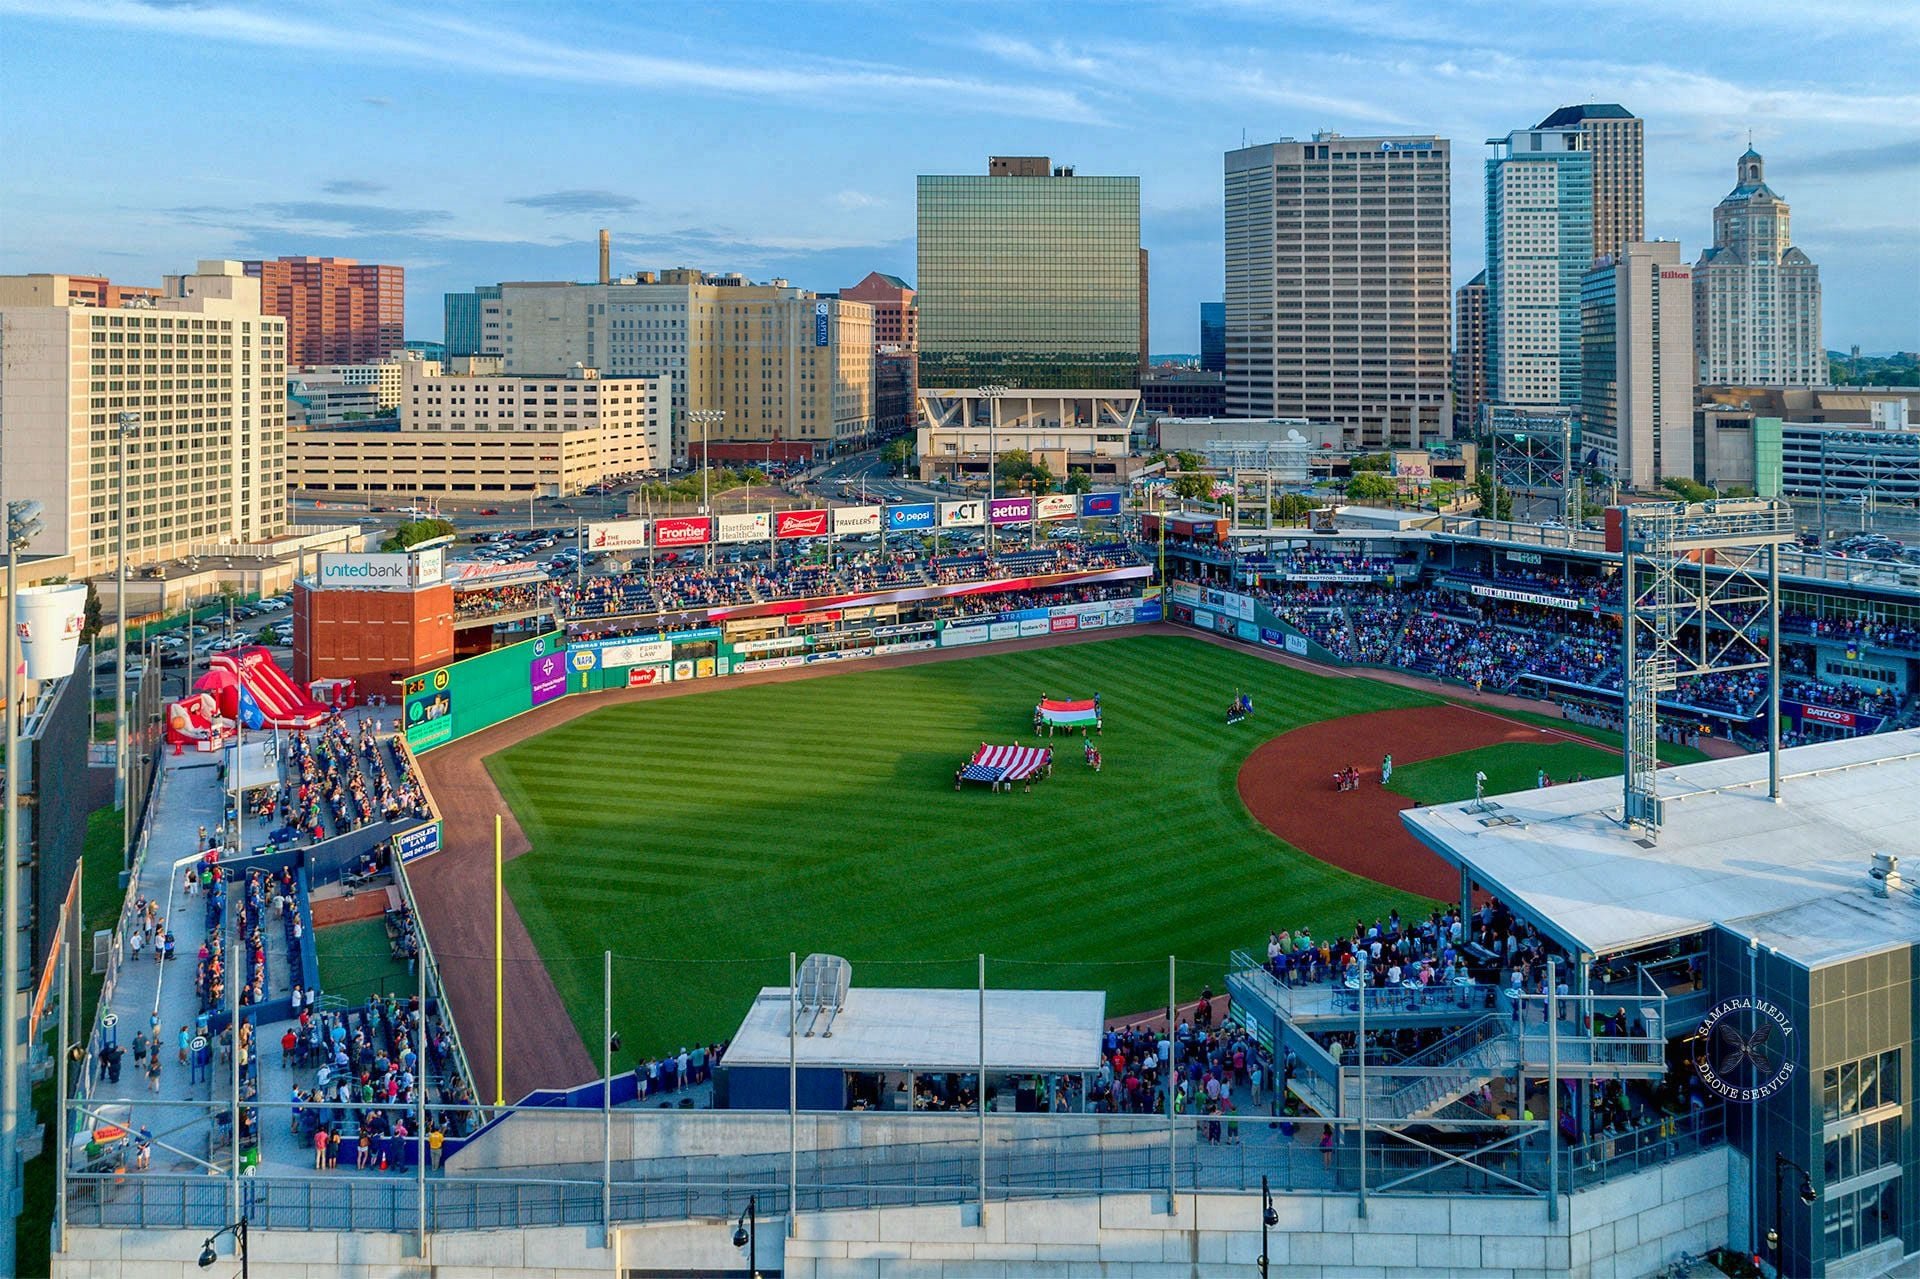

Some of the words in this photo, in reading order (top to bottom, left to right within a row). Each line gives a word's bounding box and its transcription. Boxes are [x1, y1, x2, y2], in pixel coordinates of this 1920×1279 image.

[1392, 141, 1433, 150] Prudential
[1661, 271, 1689, 279] Hilton
[820, 313, 828, 346] CAPITAL
[958, 503, 977, 519] CT
[992, 505, 1028, 518] aetna
[1044, 504, 1058, 512] SIGN
[906, 511, 930, 522] pepsi
[722, 523, 755, 533] Hartford
[783, 519, 820, 531] Budweiser
[835, 518, 872, 527] TRAVELERS
[659, 527, 706, 539] Frontier
[722, 531, 765, 541] HealthCare
[607, 539, 640, 547] HARTFORD
[325, 562, 403, 577] unitedbank
[462, 560, 539, 579] Budweiser
[535, 641, 544, 652] 42
[571, 642, 598, 650] THOMAS
[600, 640, 626, 648] HOOKER
[627, 636, 658, 644] BREWERY
[576, 655, 593, 665] NAPA
[437, 673, 446, 685] 21
[1807, 707, 1841, 719] DATTCO
[401, 827, 437, 845] DRESSLER
[410, 837, 427, 847] LAW
